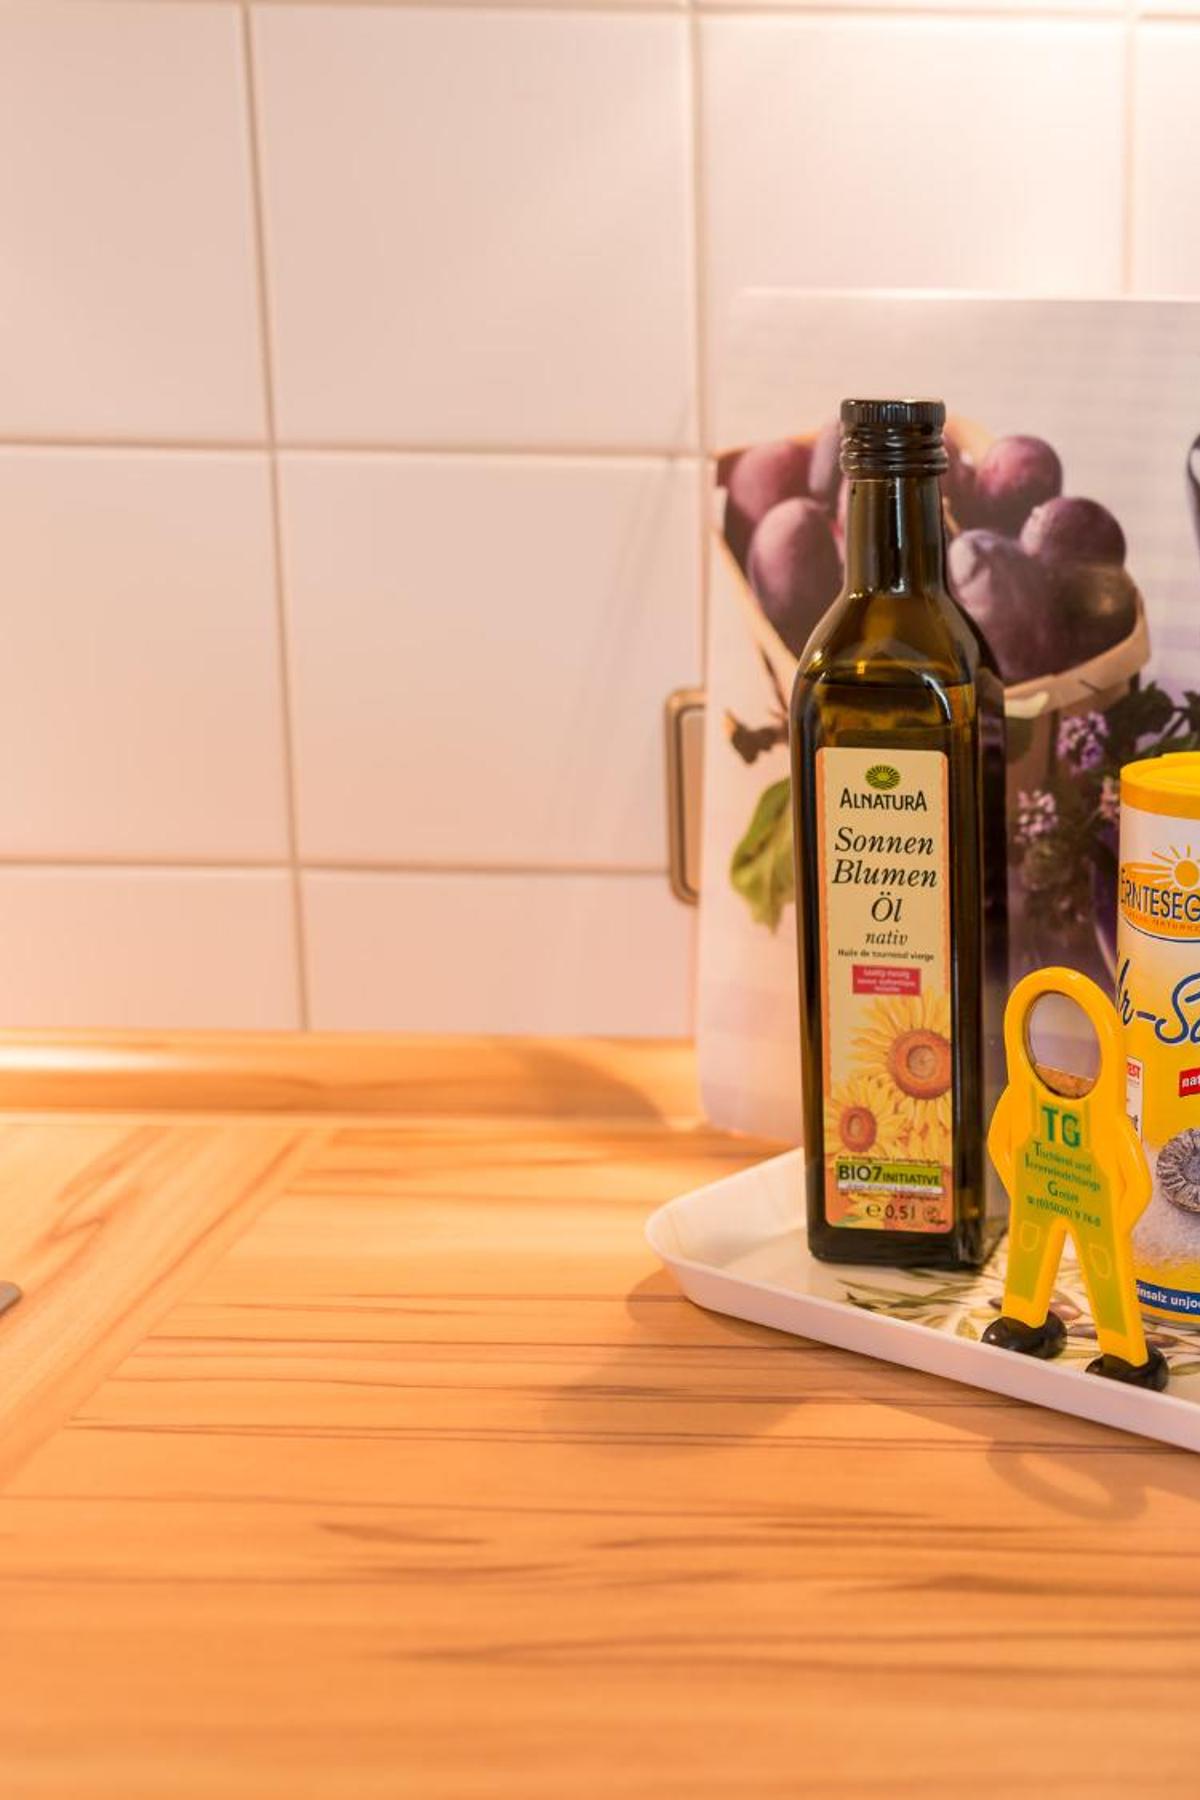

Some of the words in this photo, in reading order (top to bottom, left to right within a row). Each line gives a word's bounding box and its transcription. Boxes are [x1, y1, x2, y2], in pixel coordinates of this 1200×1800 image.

[840, 787, 927, 811] ALNATURA
[834, 826, 934, 855] Sonnen
[832, 858, 937, 888] Blumen
[871, 890, 903, 922] Öl
[865, 929, 908, 946] nativ
[1042, 1104, 1081, 1148] TG
[838, 1164, 882, 1182] BIO7
[882, 1171, 940, 1186] INITIATIVE
